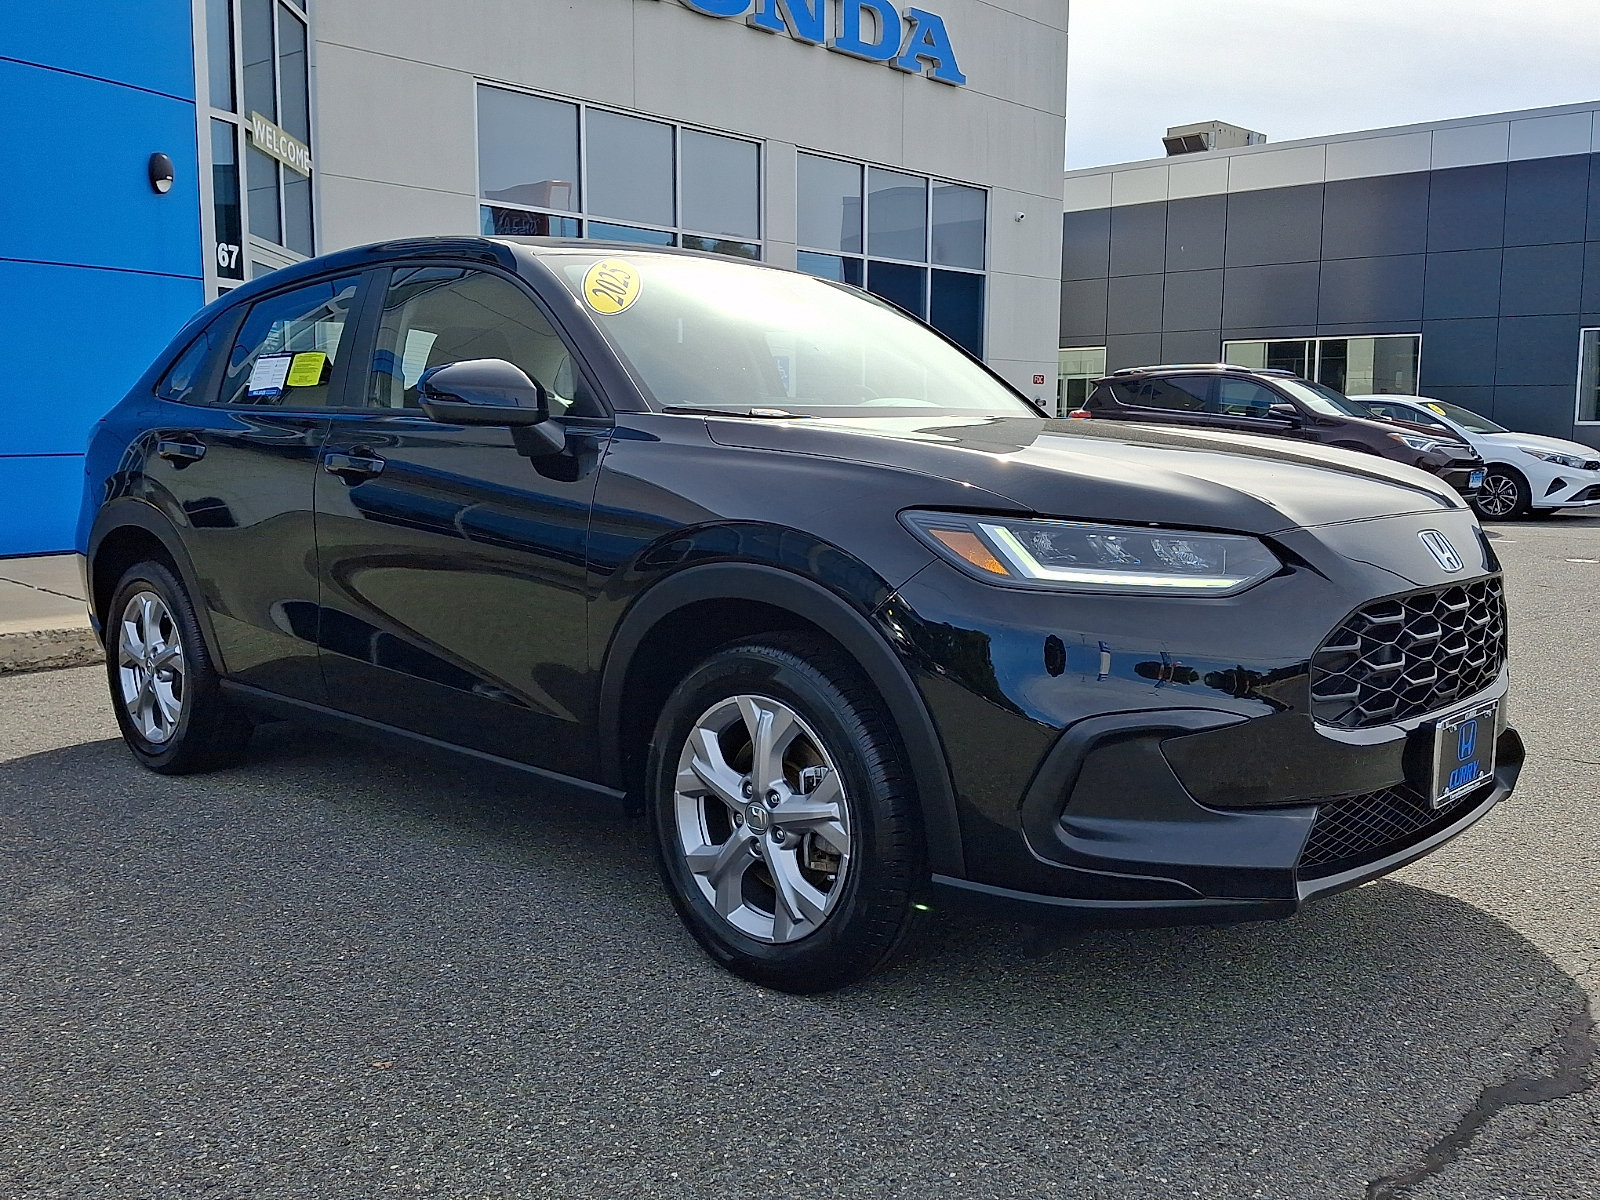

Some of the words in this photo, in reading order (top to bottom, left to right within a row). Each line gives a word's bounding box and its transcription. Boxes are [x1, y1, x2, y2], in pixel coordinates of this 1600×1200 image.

[676, 0, 967, 86] NDA
[252, 116, 310, 172] WELCOME
[217, 242, 239, 269] 67
[592, 263, 631, 307] 2025
